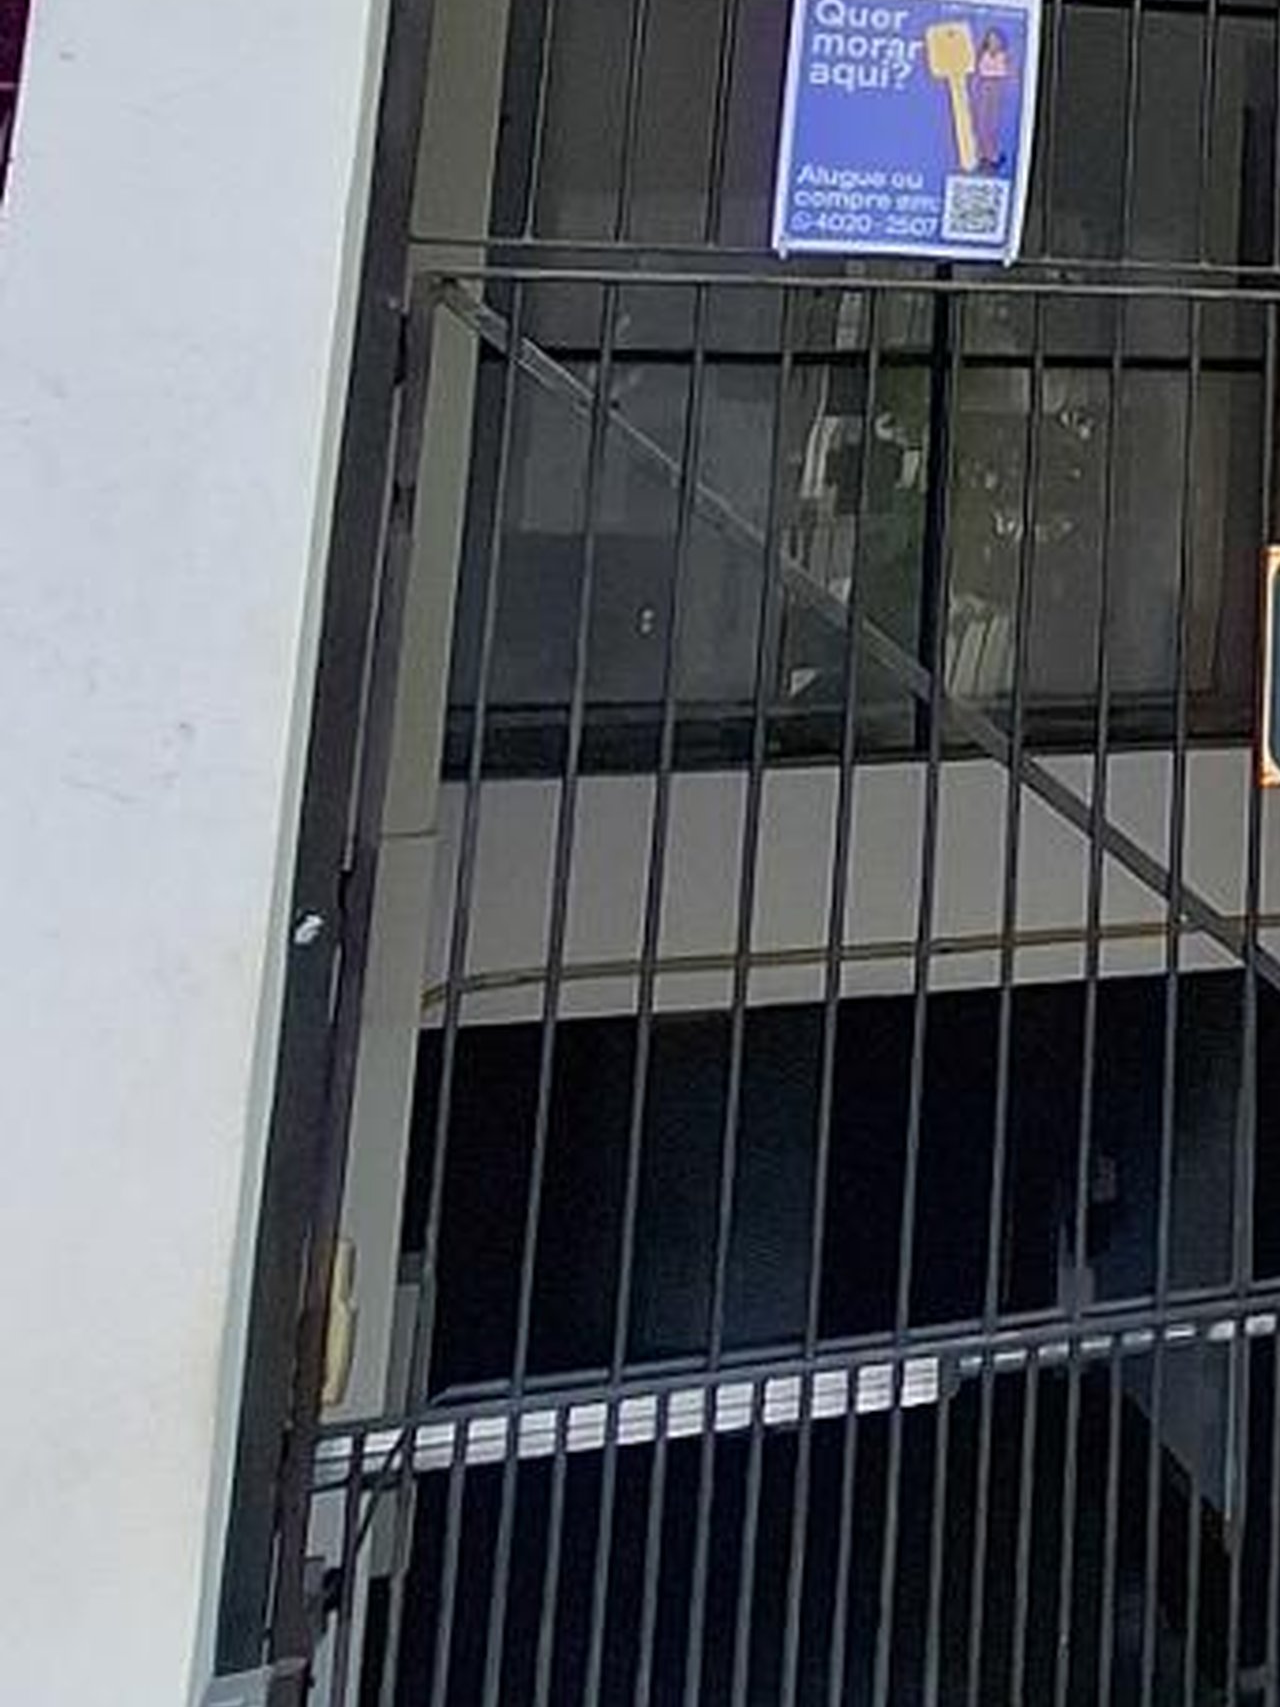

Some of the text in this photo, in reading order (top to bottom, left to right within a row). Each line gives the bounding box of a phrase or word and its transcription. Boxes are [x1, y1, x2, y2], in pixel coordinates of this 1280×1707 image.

[811, 33, 923, 61] morar
[808, 60, 912, 91] aqui?
[891, 171, 924, 188] ou
[793, 190, 892, 212] compre
